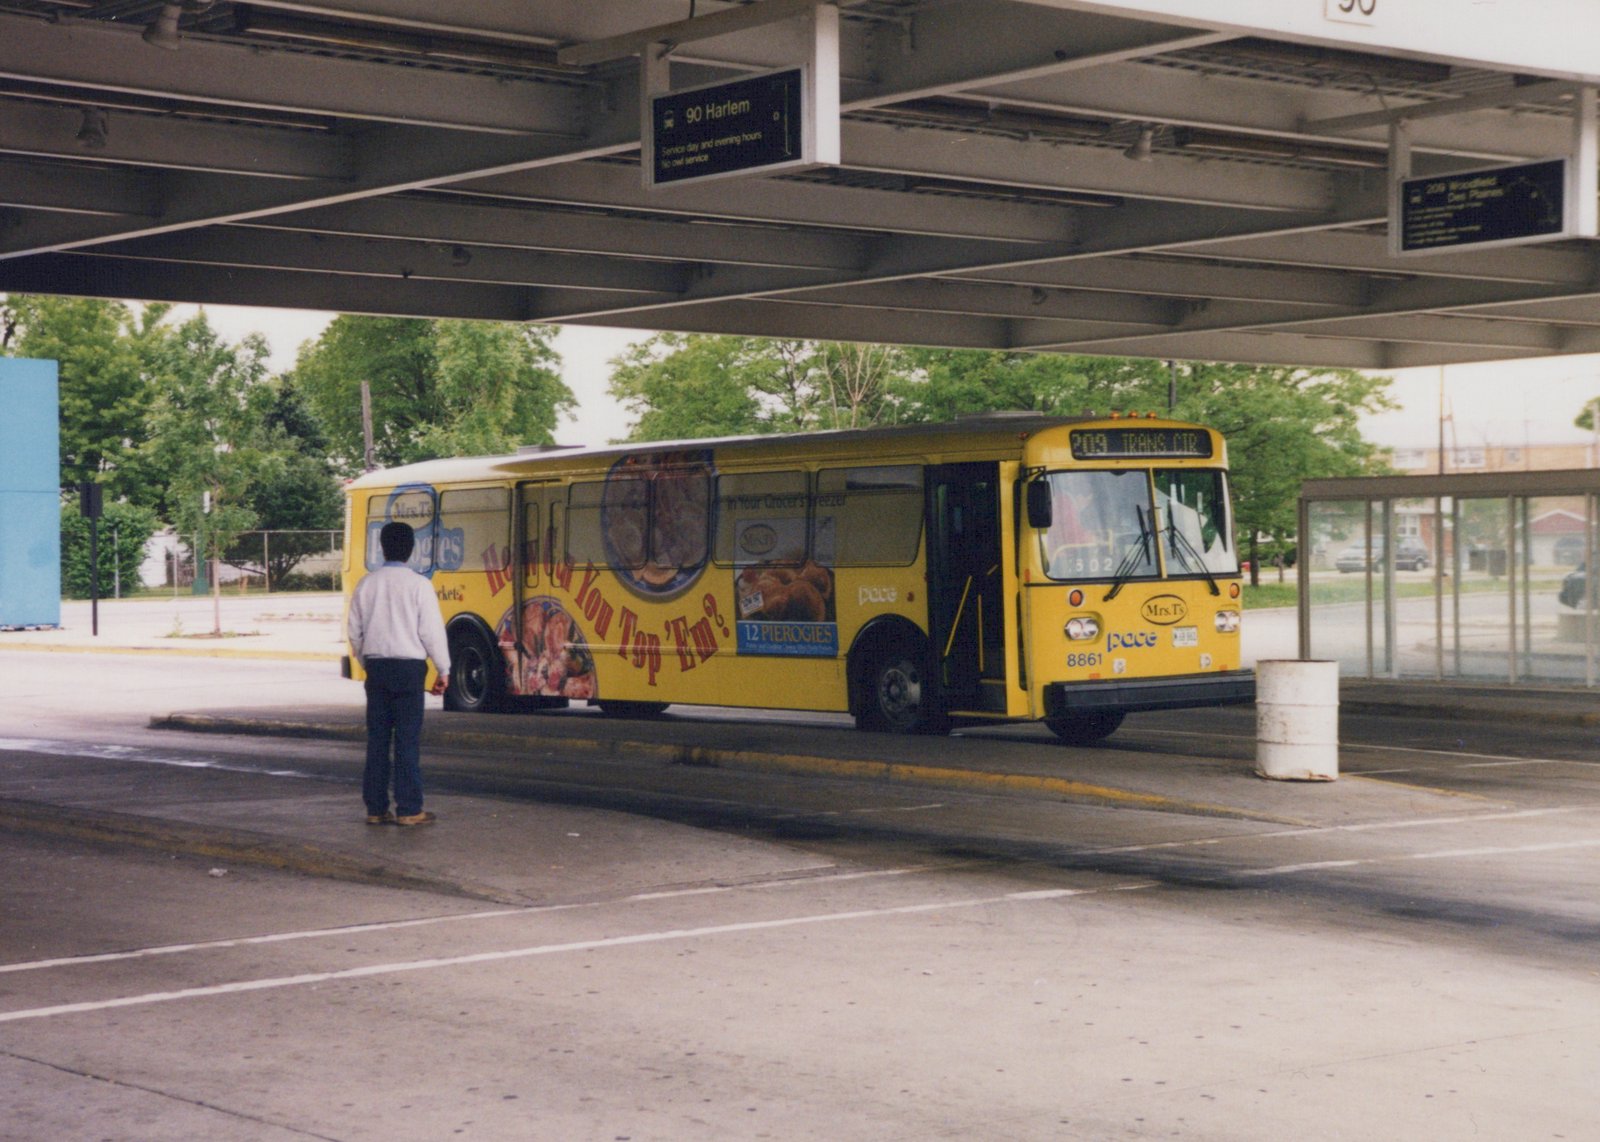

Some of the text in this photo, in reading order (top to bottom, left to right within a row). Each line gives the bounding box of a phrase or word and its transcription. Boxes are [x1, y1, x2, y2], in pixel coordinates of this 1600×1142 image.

[686, 100, 750, 124] 90 Harlem
[687, 143, 699, 153] day
[701, 139, 714, 149] and
[715, 135, 741, 145] evening
[742, 131, 762, 140] hours
[685, 154, 709, 164] service
[574, 558, 614, 641] You
[618, 605, 661, 686] Top
[745, 624, 832, 643] 12 PIEROGIES
[1107, 631, 1157, 652] pace
[1067, 653, 1102, 667] 8861
